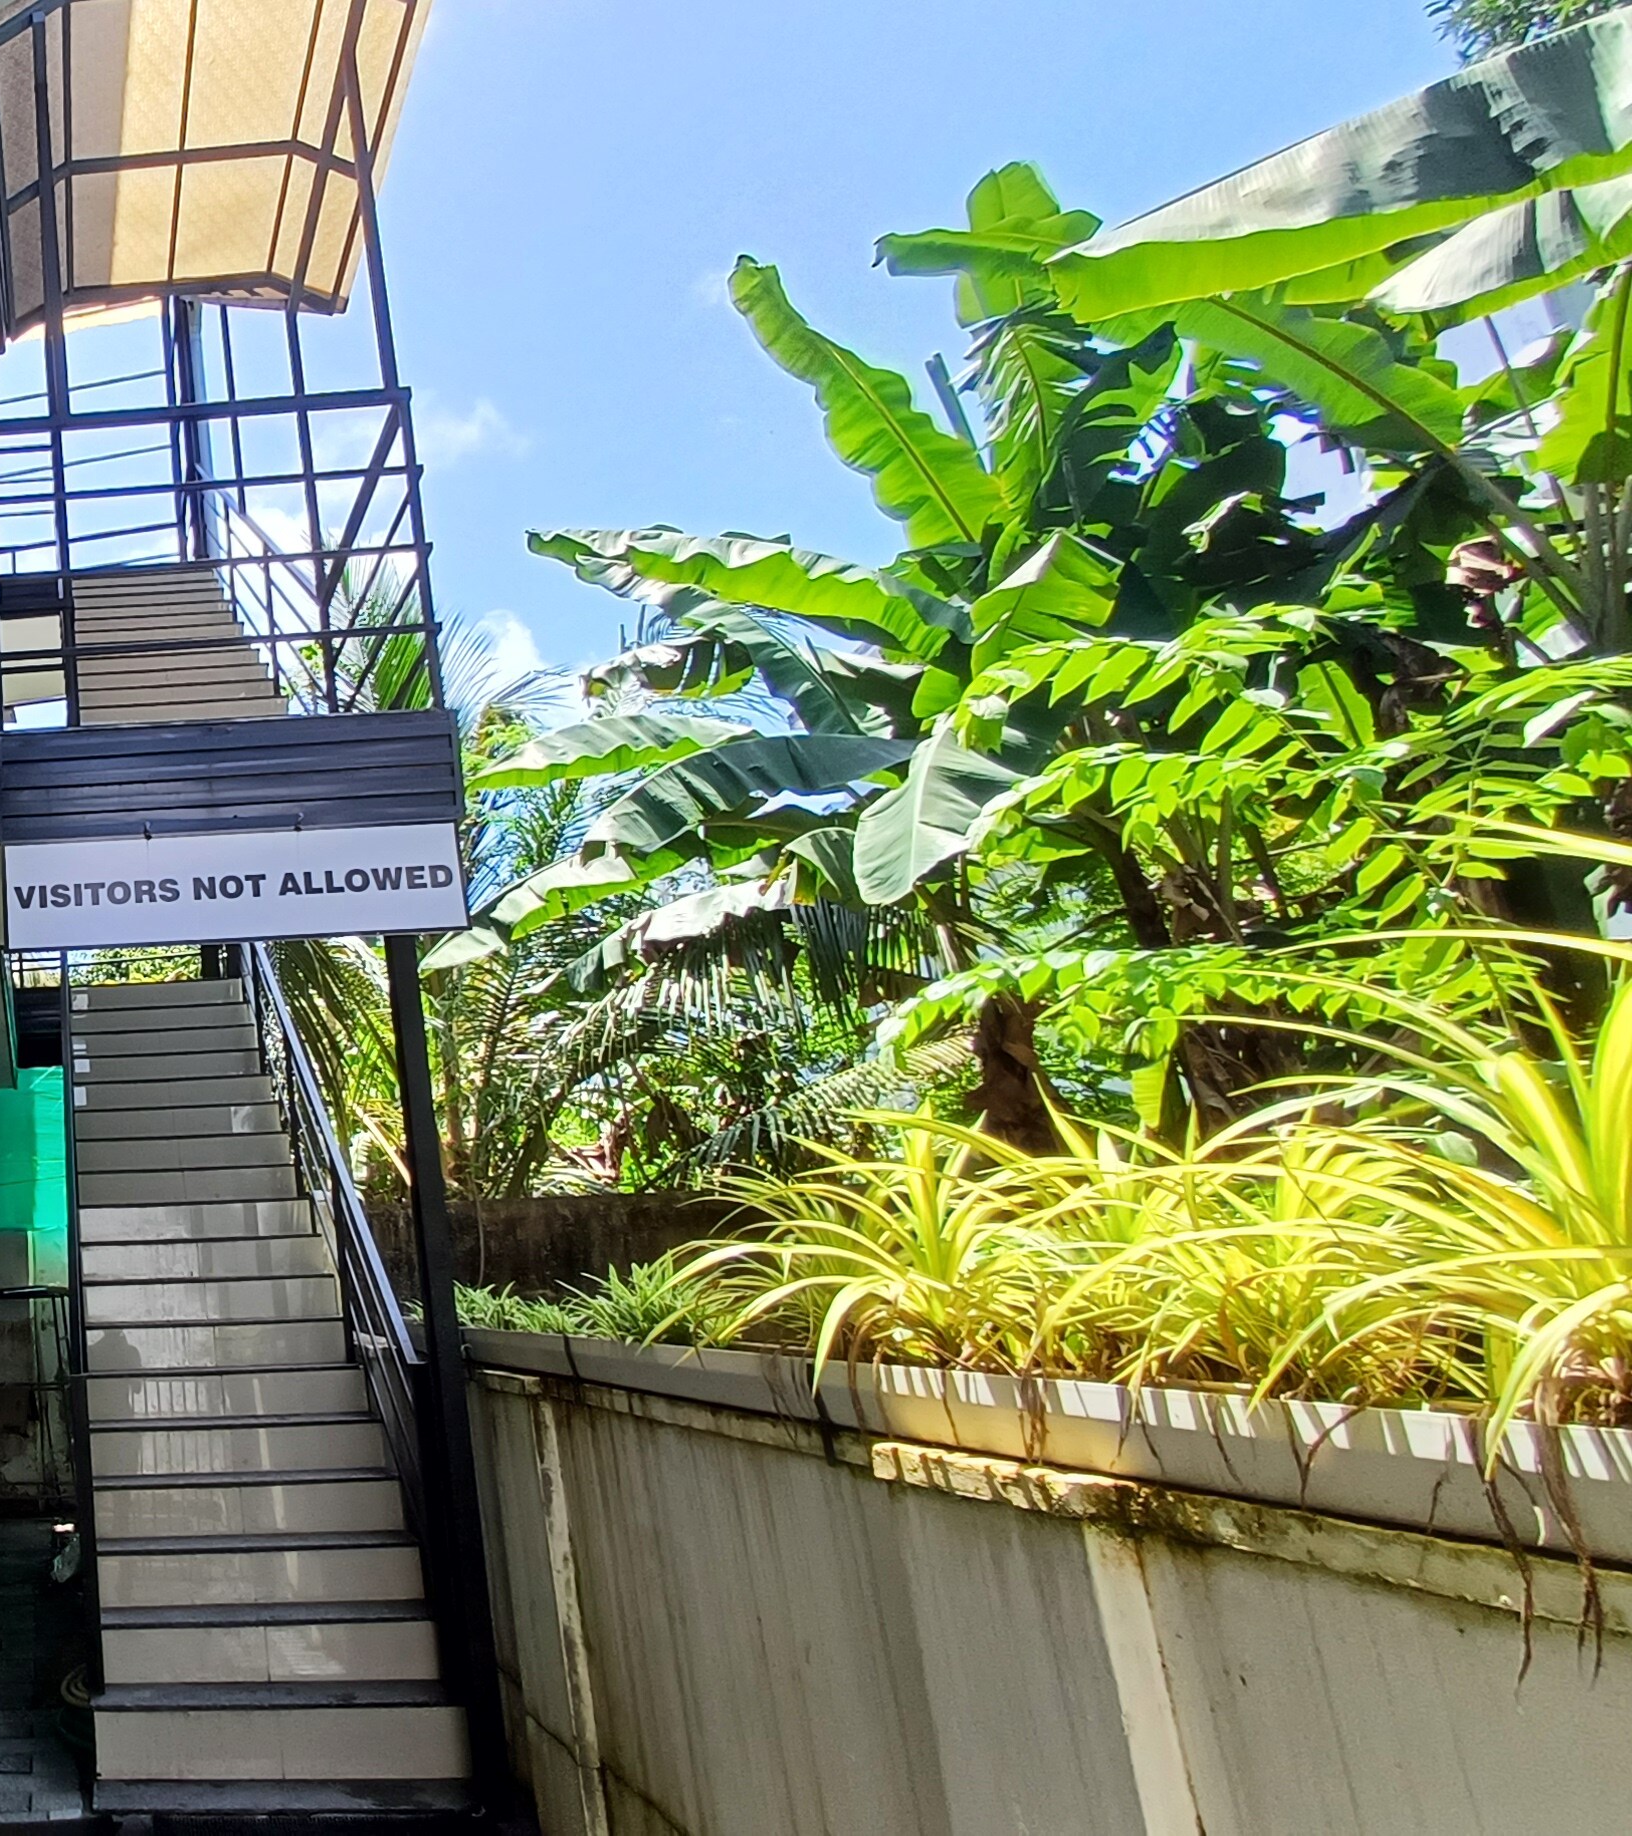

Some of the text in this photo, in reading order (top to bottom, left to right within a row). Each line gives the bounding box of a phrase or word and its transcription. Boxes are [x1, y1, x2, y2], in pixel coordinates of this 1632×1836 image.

[13, 864, 454, 910] VISITORS NOT ALLOWED
